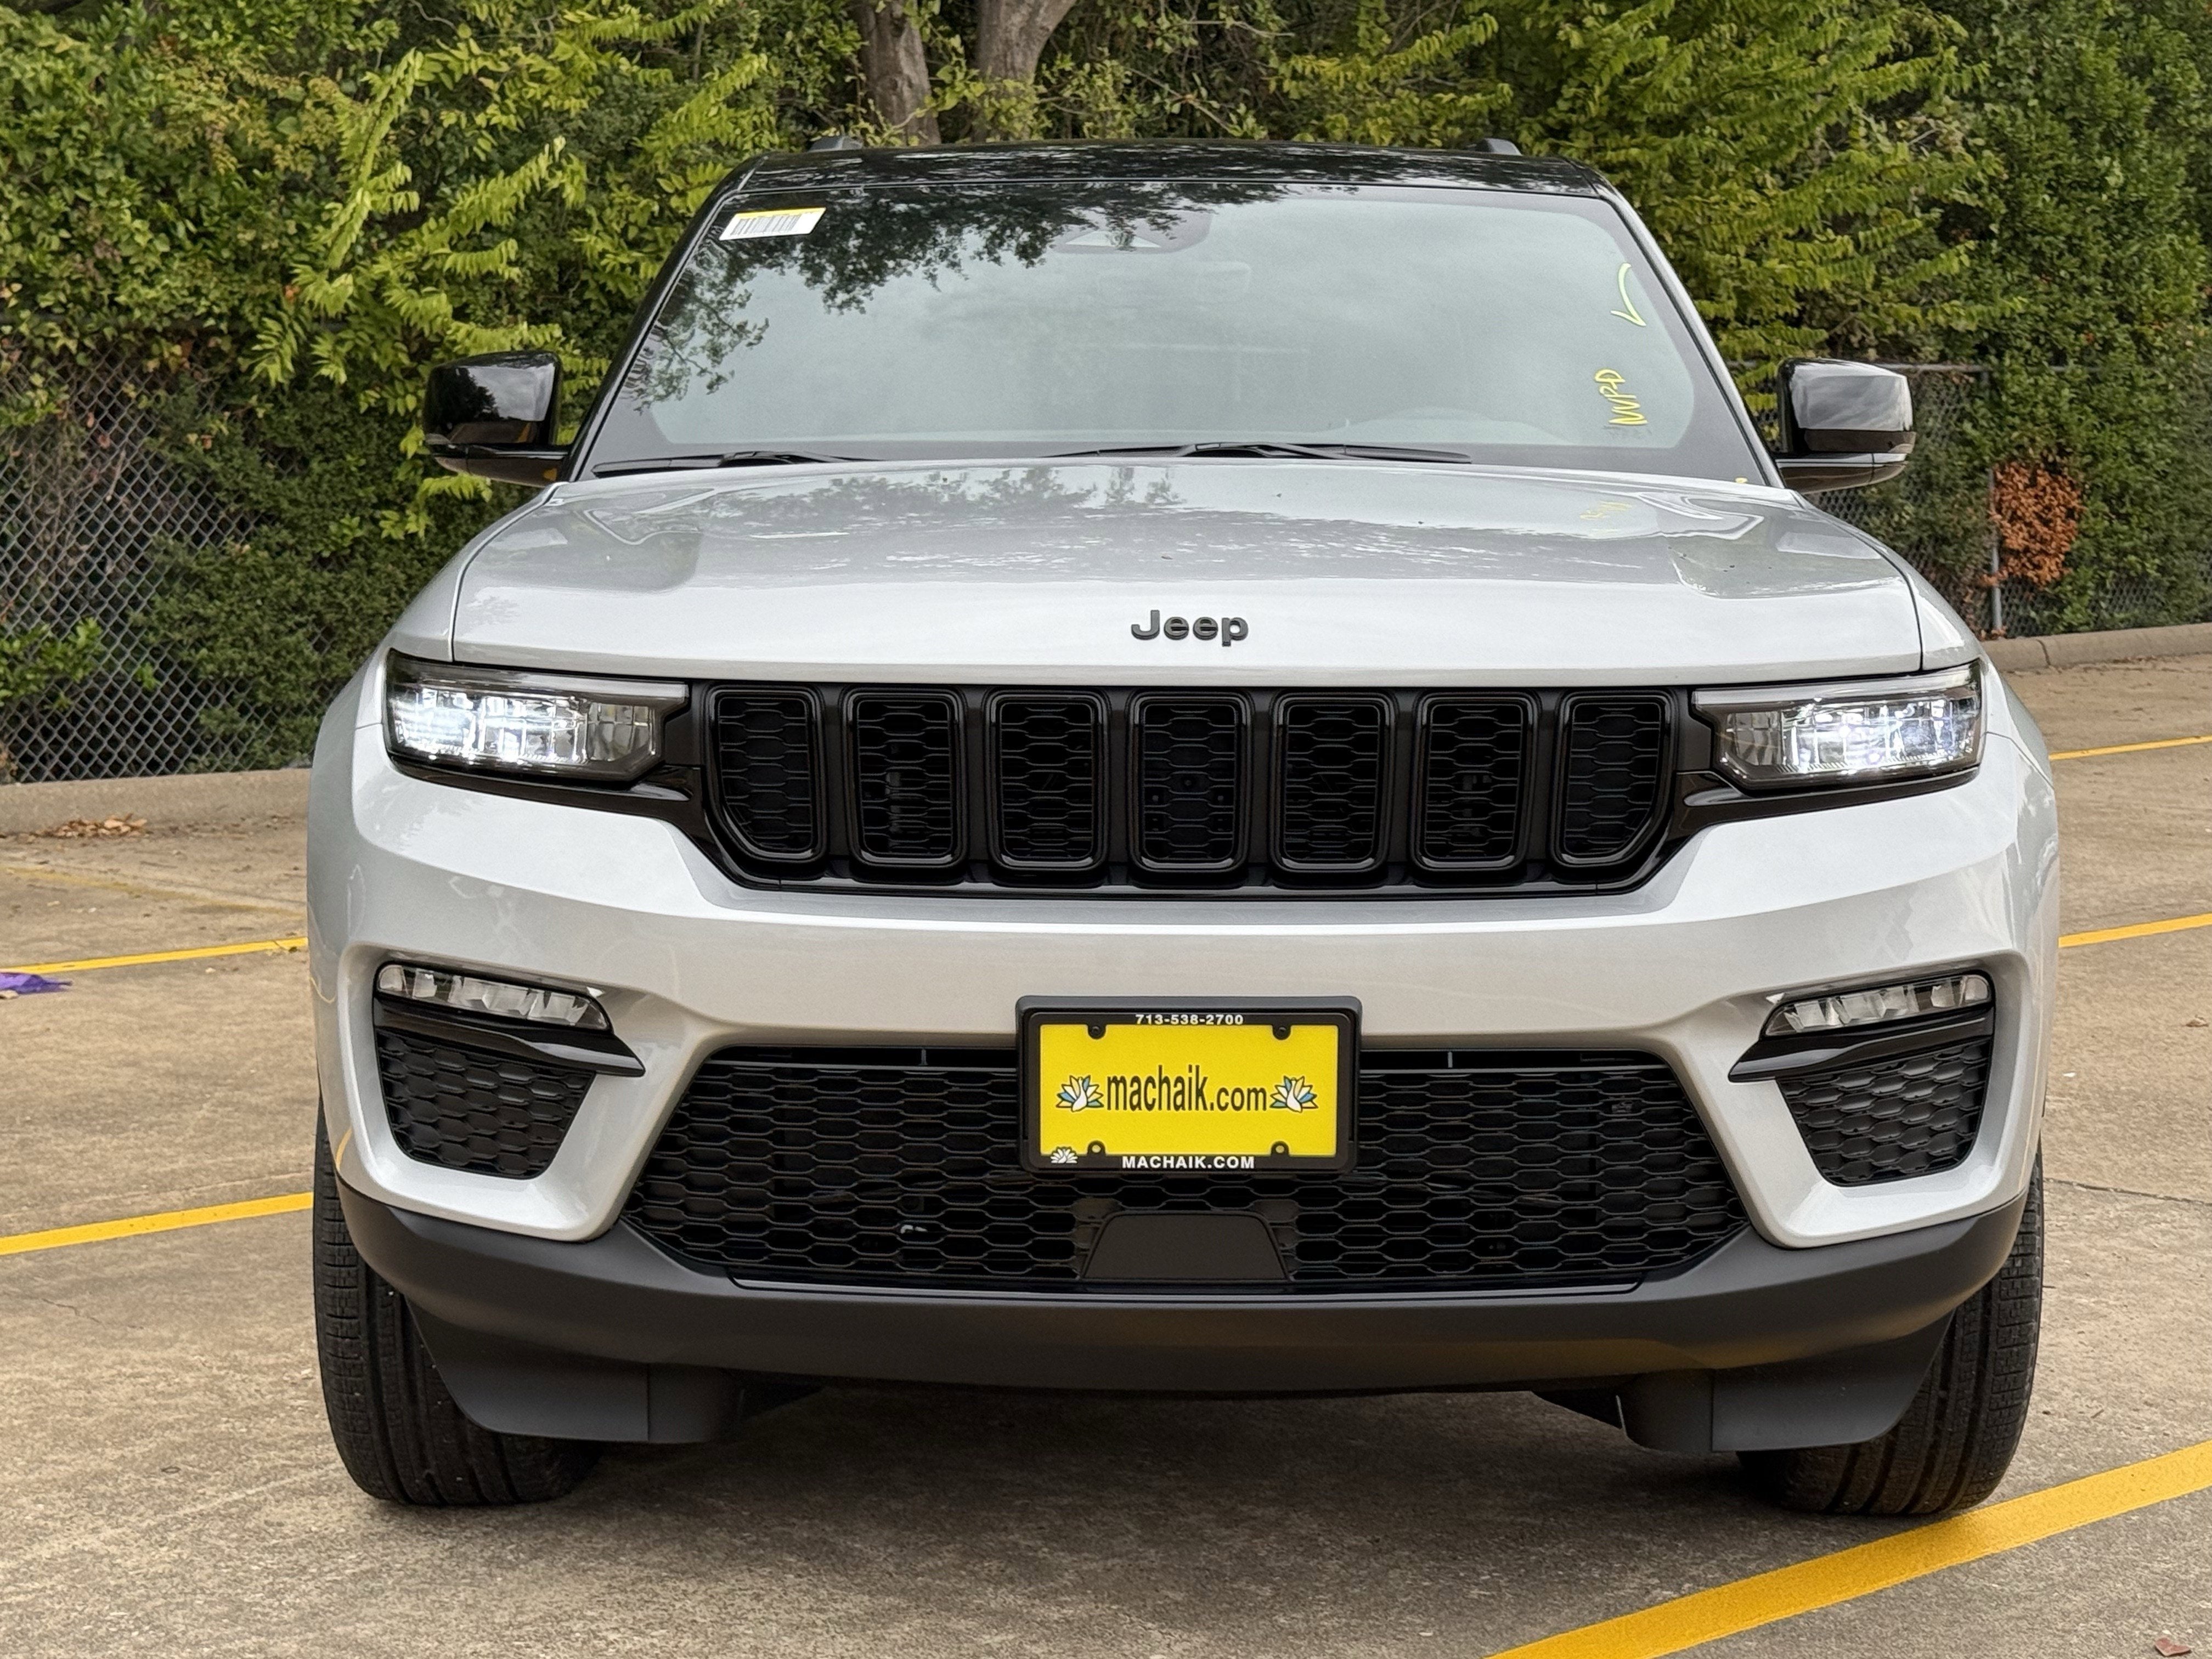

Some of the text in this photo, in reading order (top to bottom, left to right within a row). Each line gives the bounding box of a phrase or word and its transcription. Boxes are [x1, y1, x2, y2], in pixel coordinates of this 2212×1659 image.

[1131, 610, 1249, 647] Jeep
[1135, 1014, 1244, 1025] 713-538-2700
[1107, 1065, 1267, 1111] machaik.com
[1122, 1156, 1255, 1169] MACHAIK.COM
